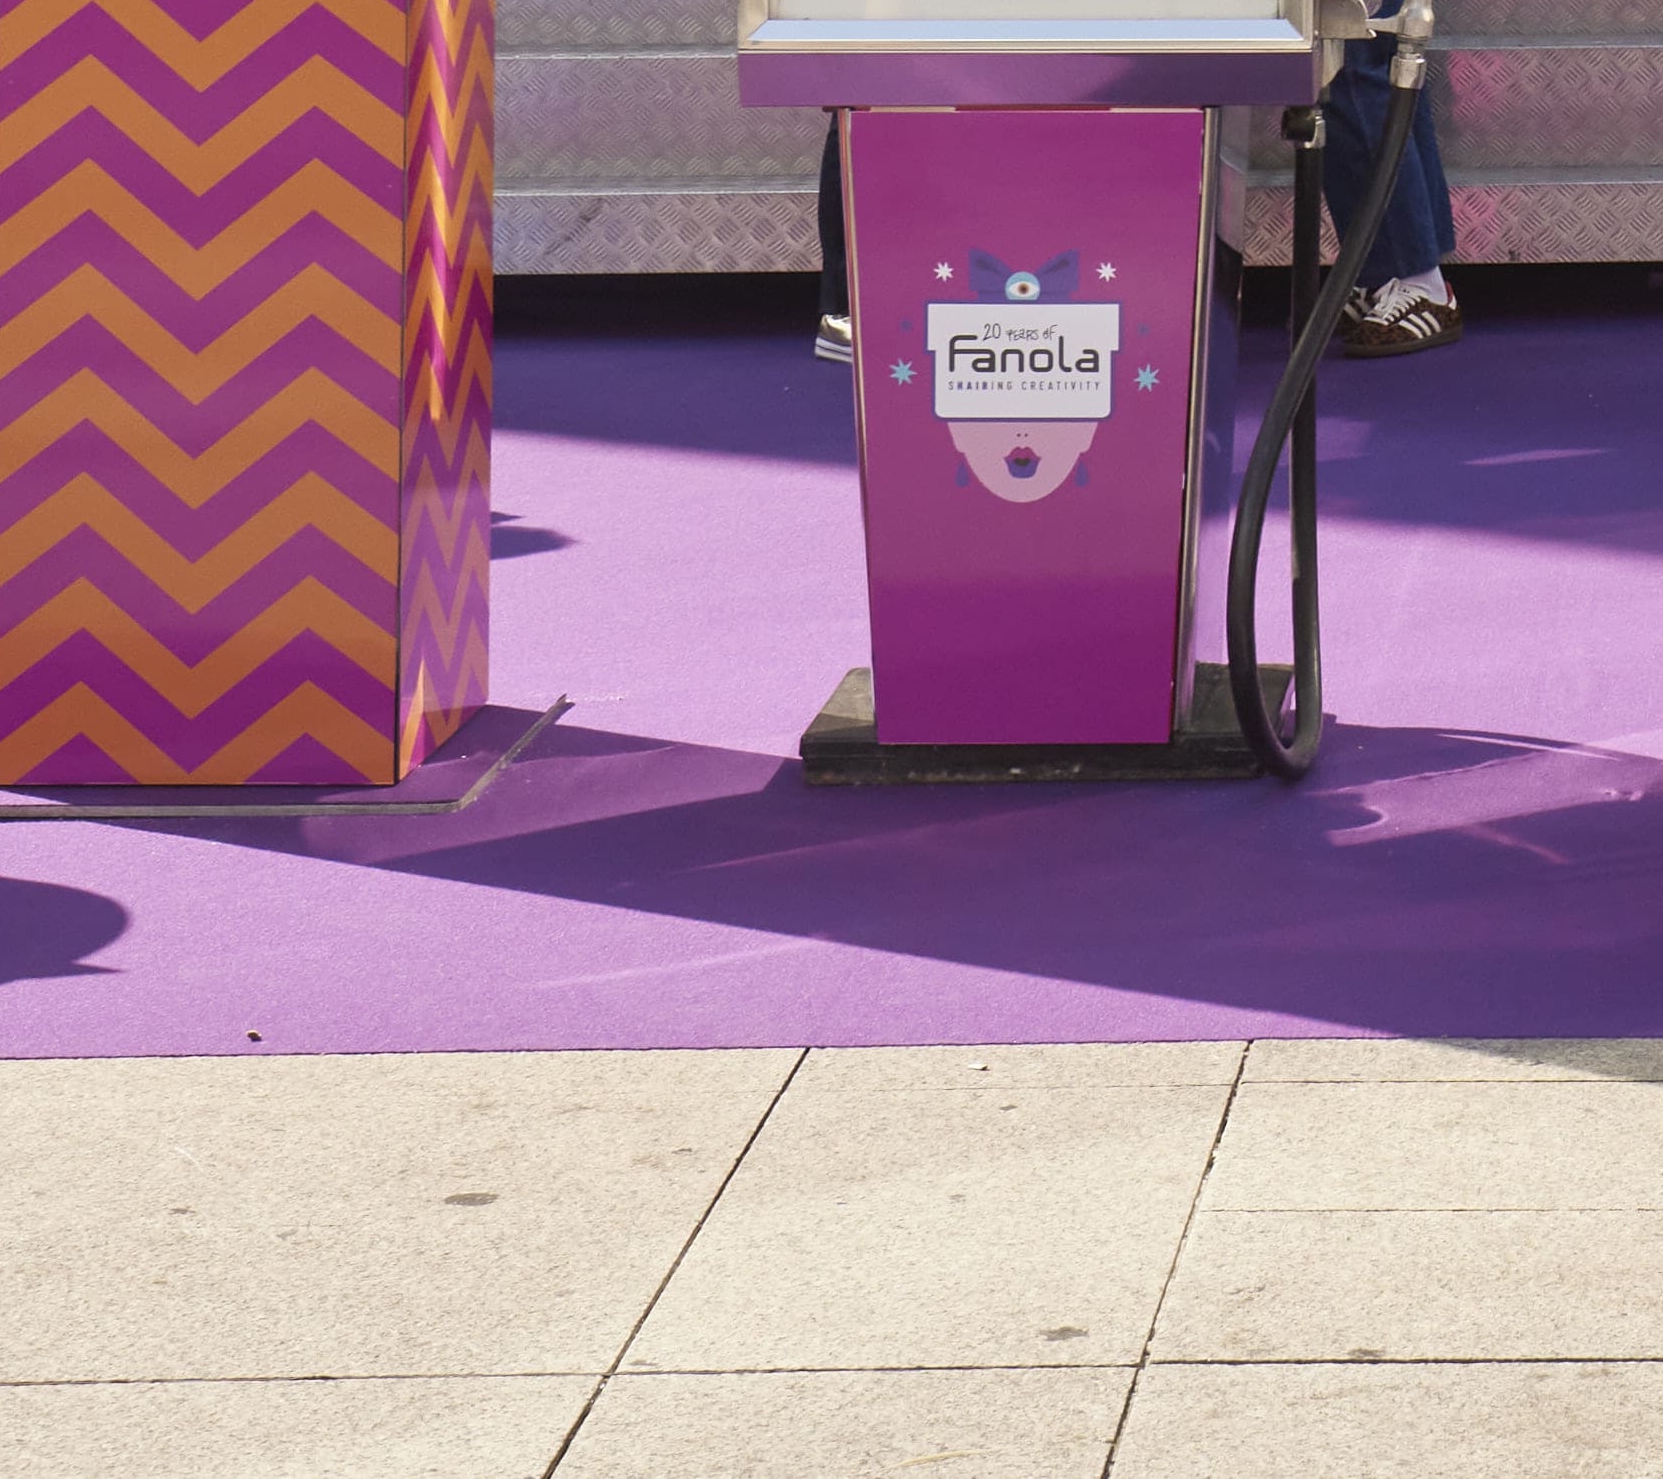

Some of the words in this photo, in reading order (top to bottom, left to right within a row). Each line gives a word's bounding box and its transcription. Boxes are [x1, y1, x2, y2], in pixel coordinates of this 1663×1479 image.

[981, 322, 1003, 343] 20
[947, 332, 1101, 375] Fanola
[947, 380, 1015, 392] SHAIRING
[1020, 379, 1102, 392] CREATIVITY
